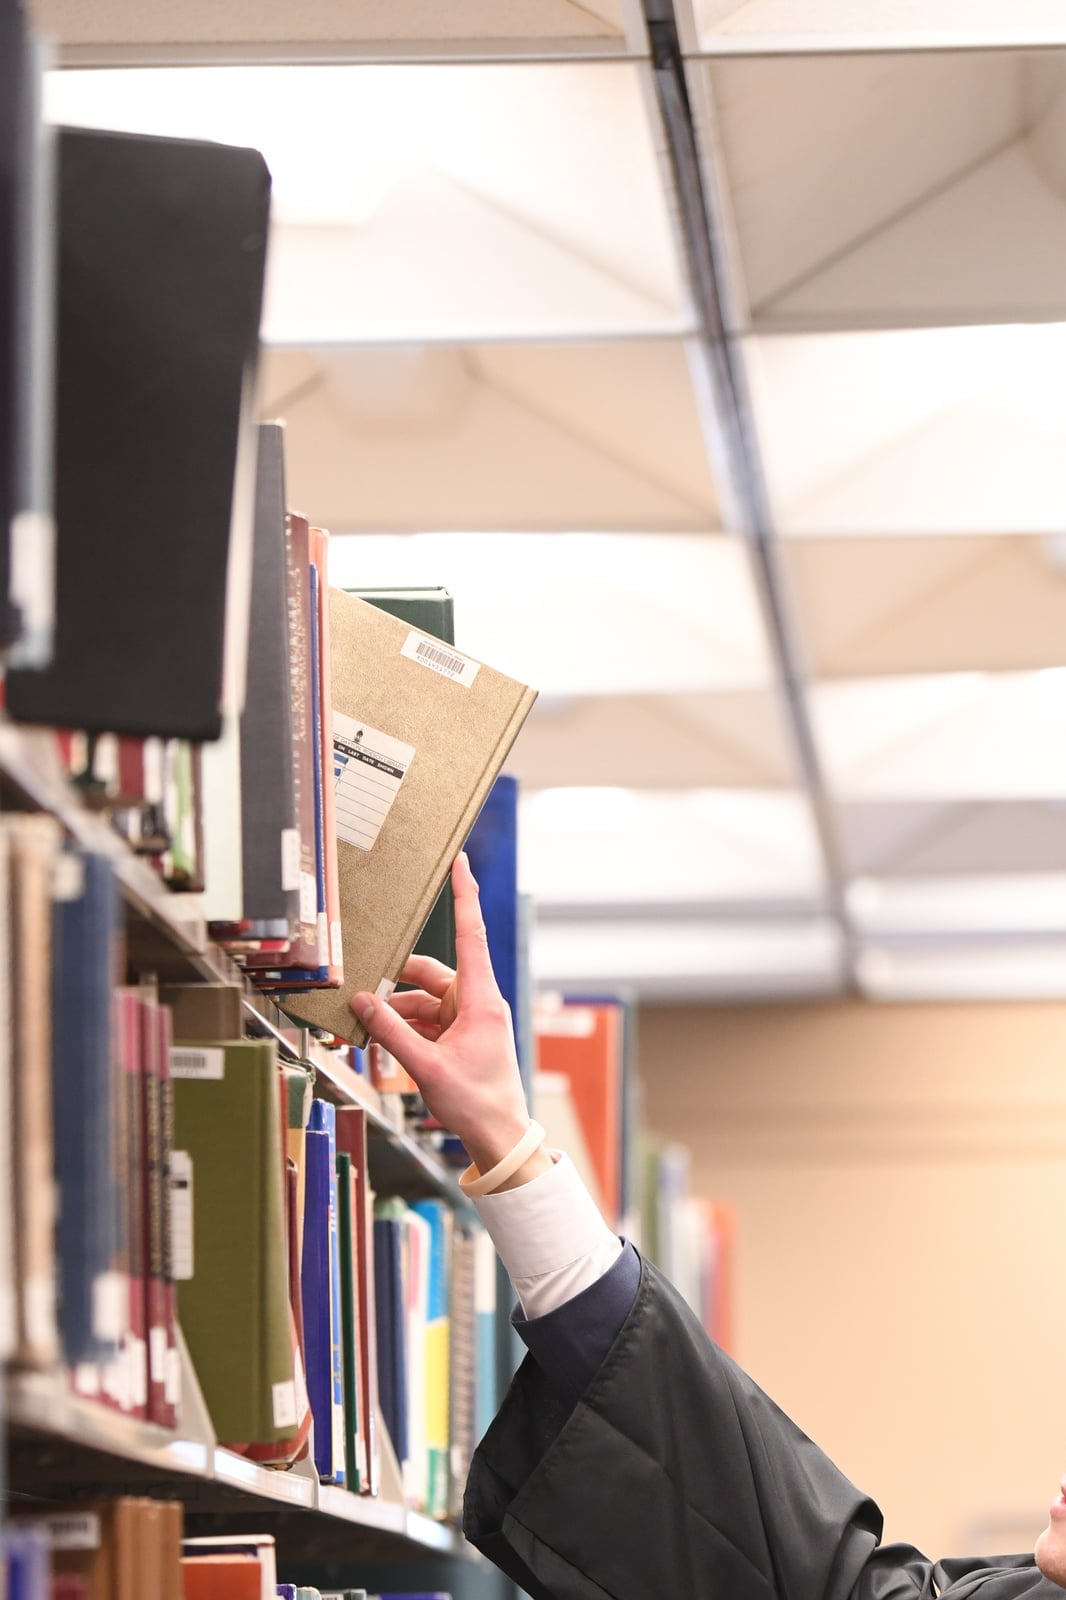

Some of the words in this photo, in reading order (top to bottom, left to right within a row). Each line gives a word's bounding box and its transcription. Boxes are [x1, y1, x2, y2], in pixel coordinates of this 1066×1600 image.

[337, 744, 346, 752] ON
[348, 748, 360, 758] LAST
[362, 755, 375, 765] DATE
[377, 762, 395, 774] SHOWN
